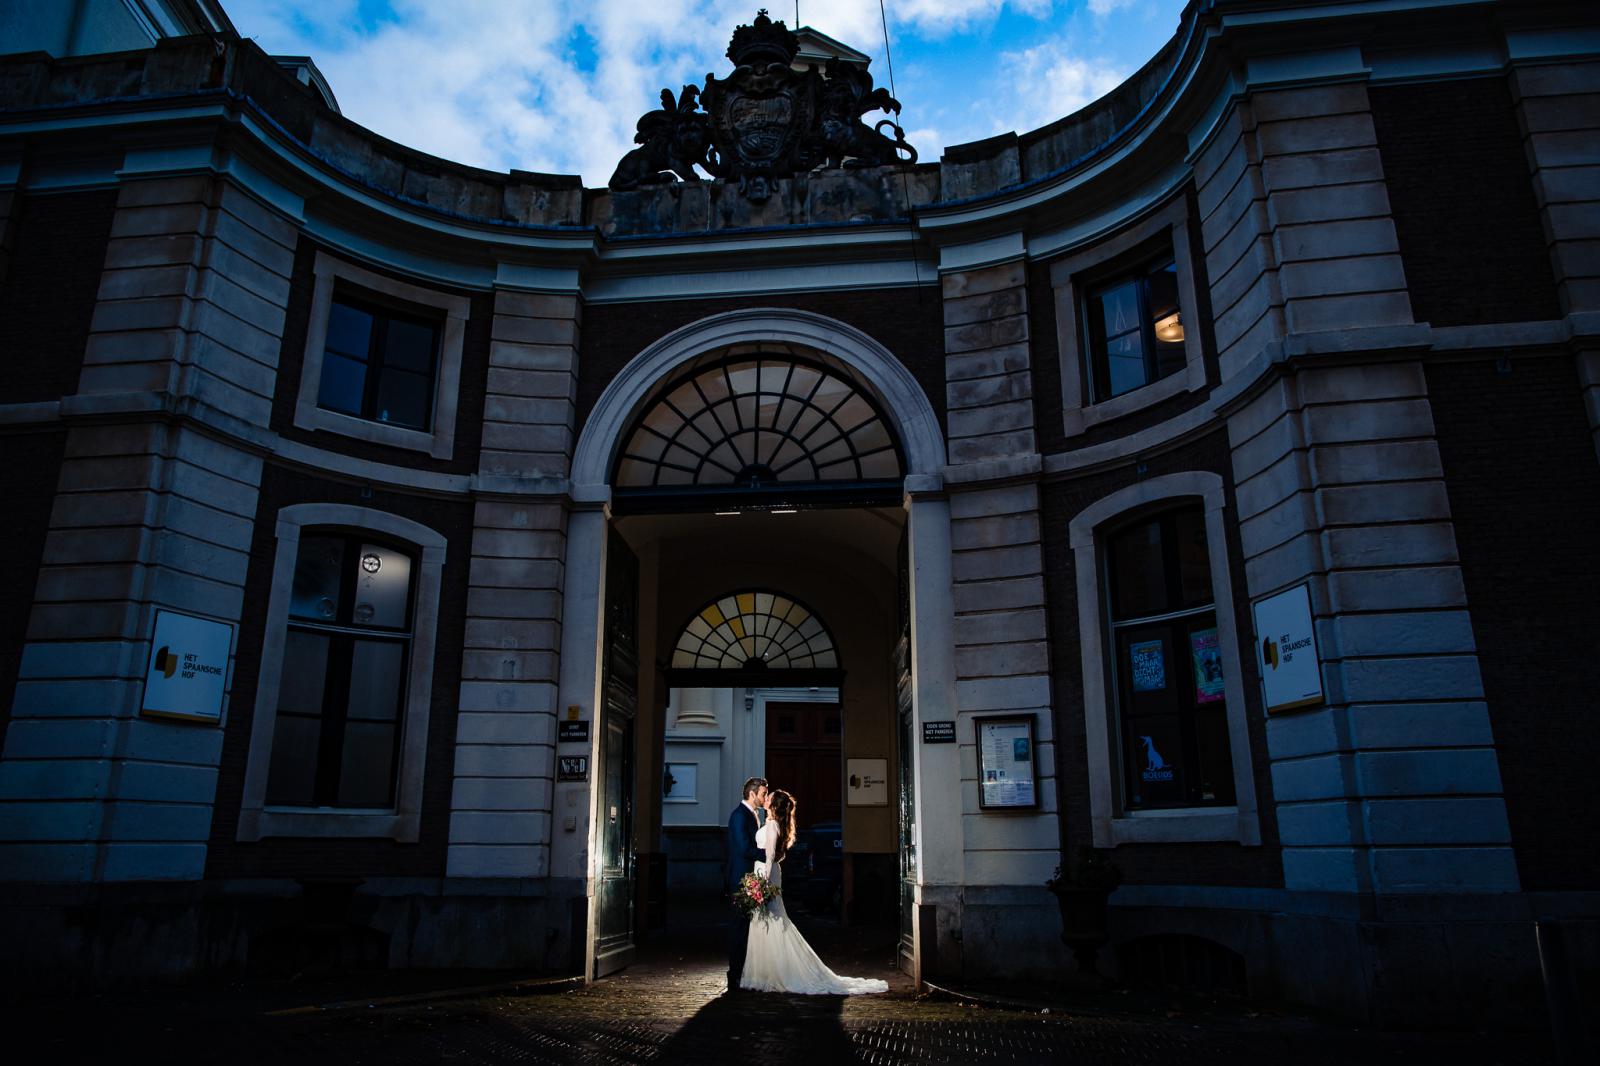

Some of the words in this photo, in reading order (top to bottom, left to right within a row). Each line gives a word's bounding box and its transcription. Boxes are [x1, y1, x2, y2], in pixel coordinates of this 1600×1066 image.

[1281, 634, 1290, 644] HET
[1282, 637, 1311, 652] SPAANSCHE
[184, 653, 198, 662] HET
[1282, 653, 1292, 663] HOF
[182, 670, 196, 678] HOF
[184, 662, 222, 676] SPAANSCHE
